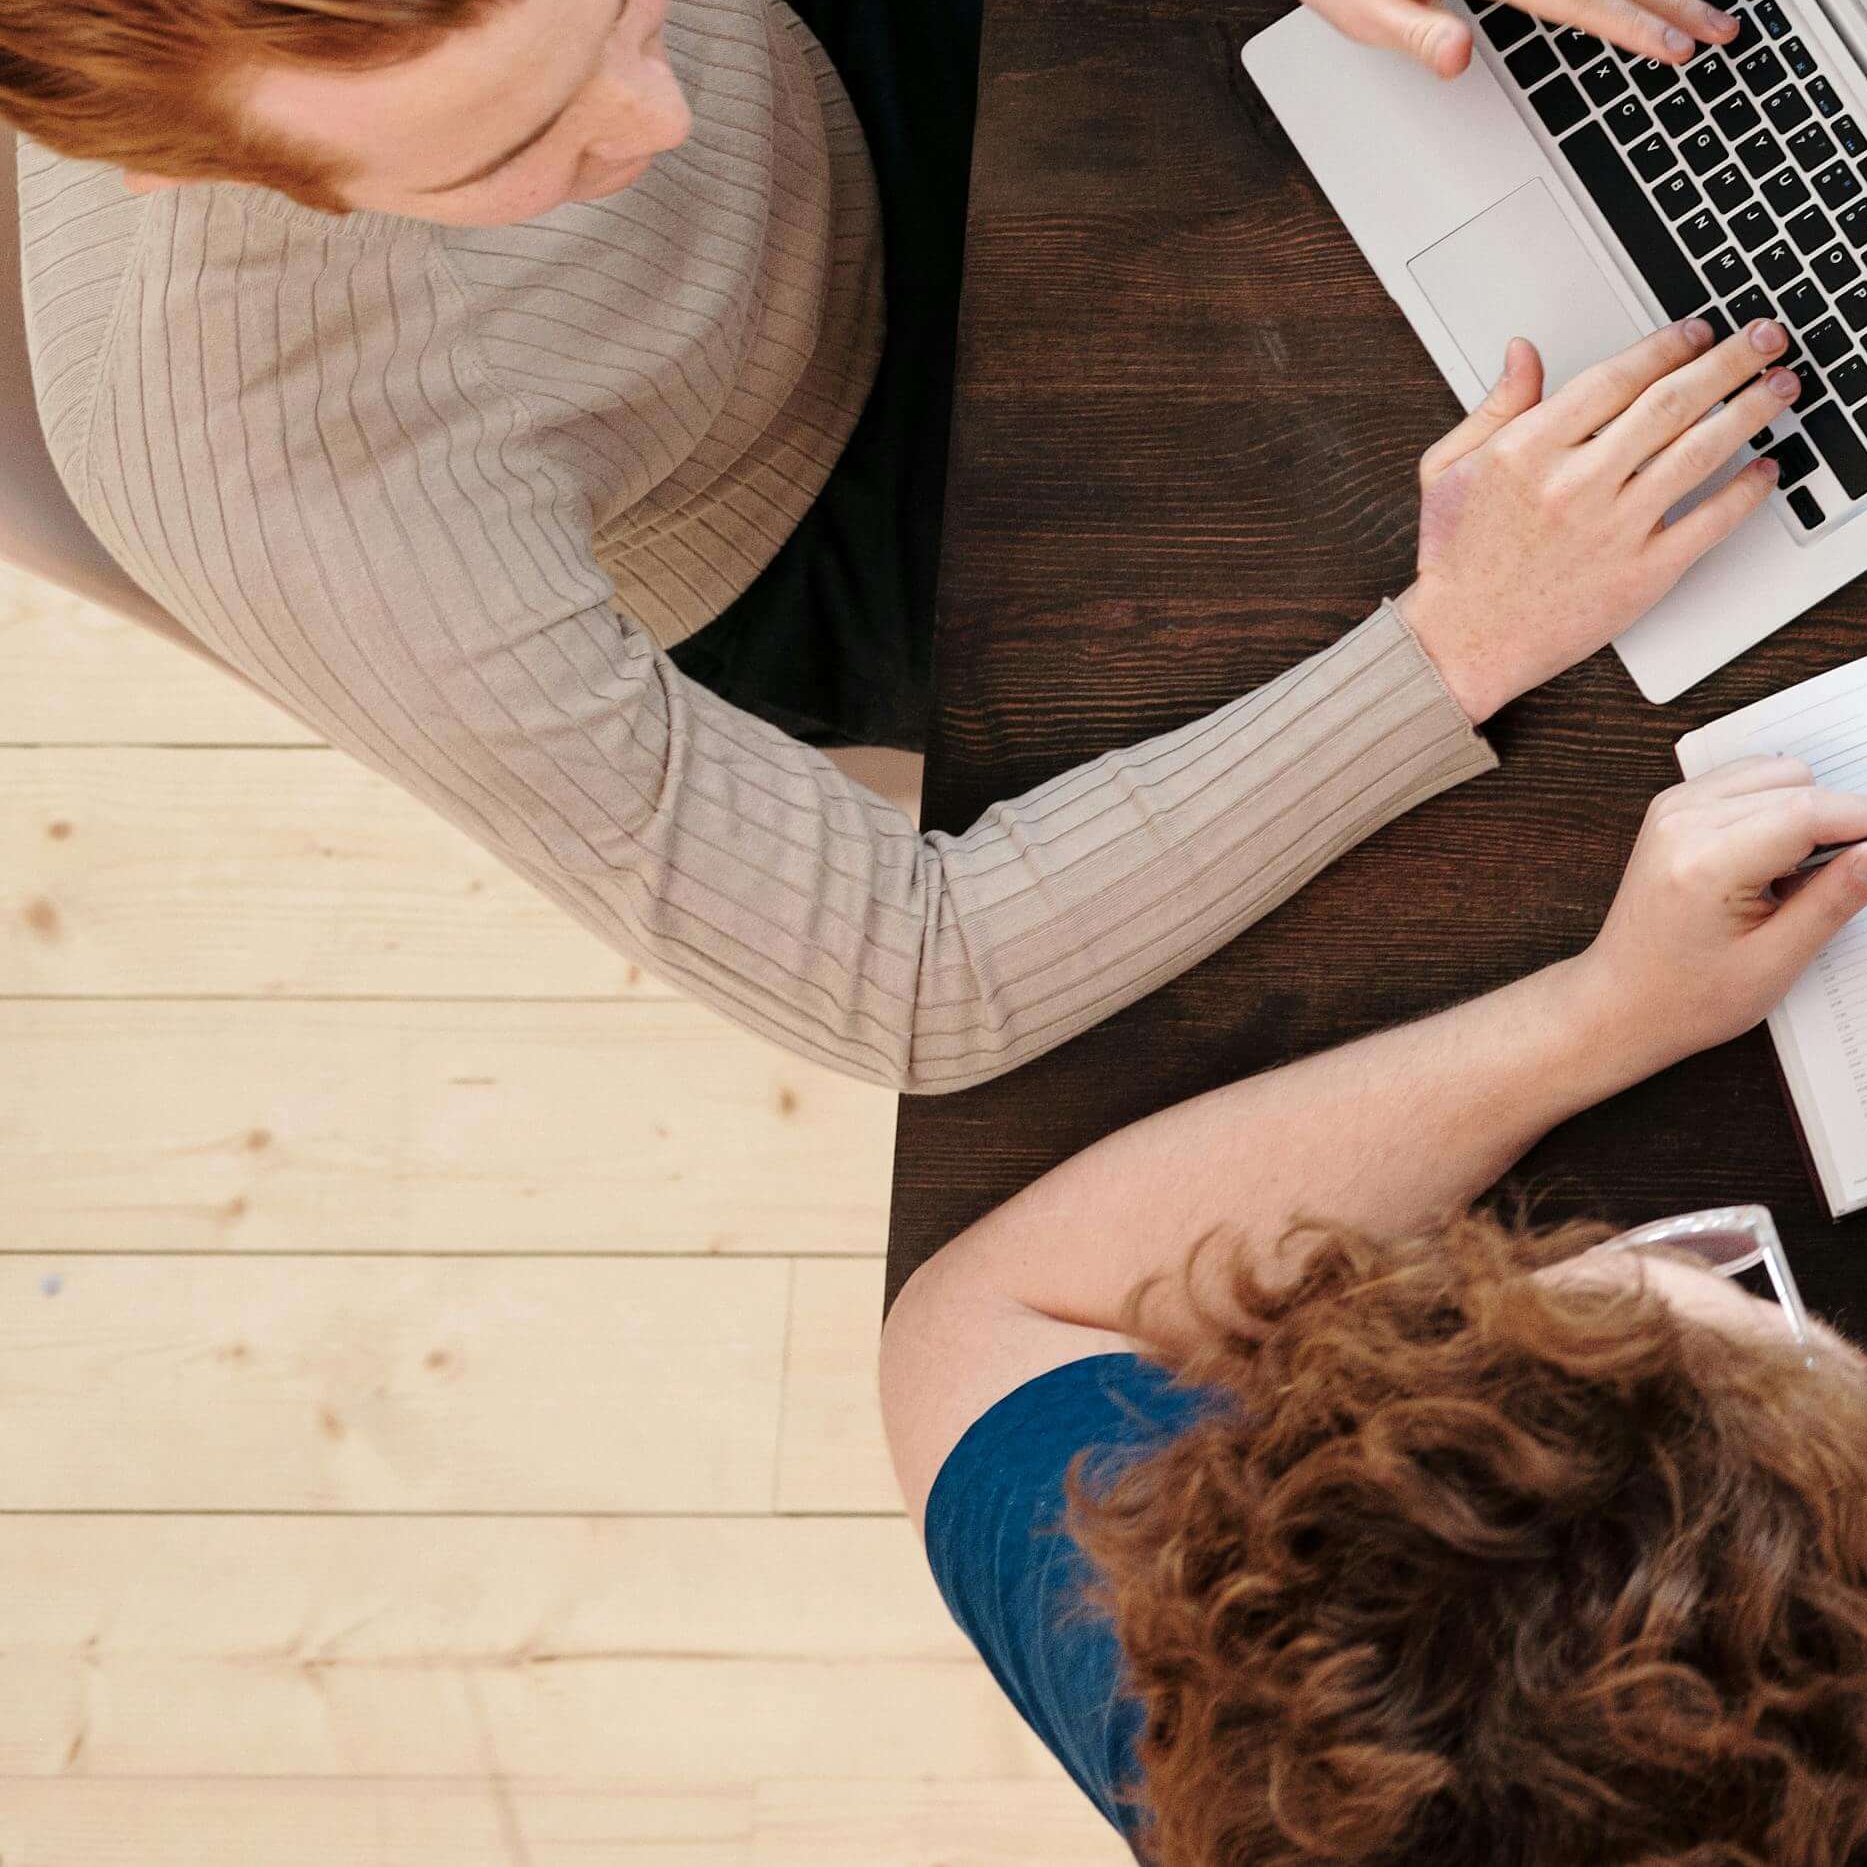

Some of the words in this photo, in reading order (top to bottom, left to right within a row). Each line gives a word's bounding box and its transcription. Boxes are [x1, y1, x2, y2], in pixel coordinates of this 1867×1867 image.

[1572, 27, 1586, 40] Z
[1647, 57, 1660, 70] D
[1703, 59, 1717, 74] R
[1596, 65, 1611, 79] X
[1671, 95, 1685, 105] F
[1730, 97, 1743, 109] T
[1622, 103, 1636, 116] C
[1647, 139, 1660, 152] V
[1697, 134, 1710, 147] G
[1755, 135, 1768, 147] Y
[1721, 170, 1736, 185] H
[1779, 172, 1793, 186] U
[1821, 174, 1831, 184] 8
[1670, 178, 1684, 191] B
[1694, 215, 1710, 230] N
[1771, 246, 1785, 261] K
[1830, 250, 1843, 264] O
[1720, 253, 1736, 269] M
[1796, 285, 1807, 298] L
[1853, 287, 1867, 298] P
